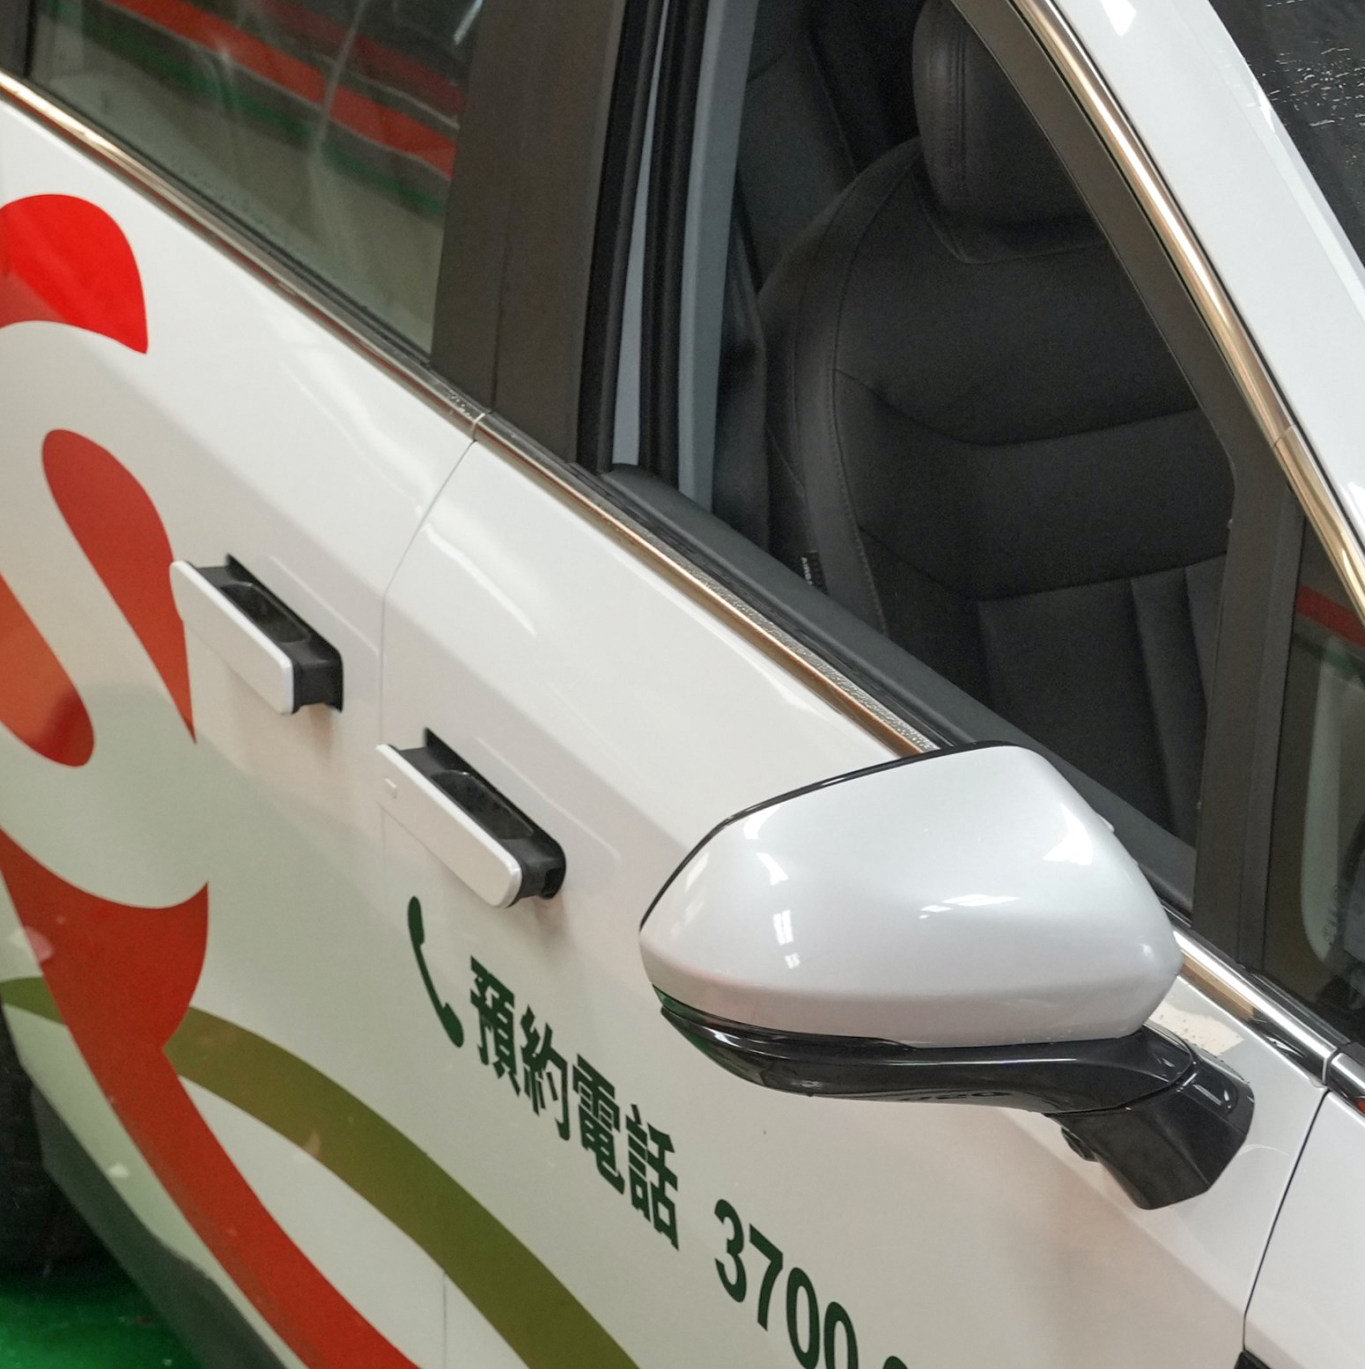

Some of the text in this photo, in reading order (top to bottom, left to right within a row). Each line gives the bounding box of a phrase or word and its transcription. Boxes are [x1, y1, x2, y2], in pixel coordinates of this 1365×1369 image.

[470, 955, 860, 1369] 預約電話 3700
